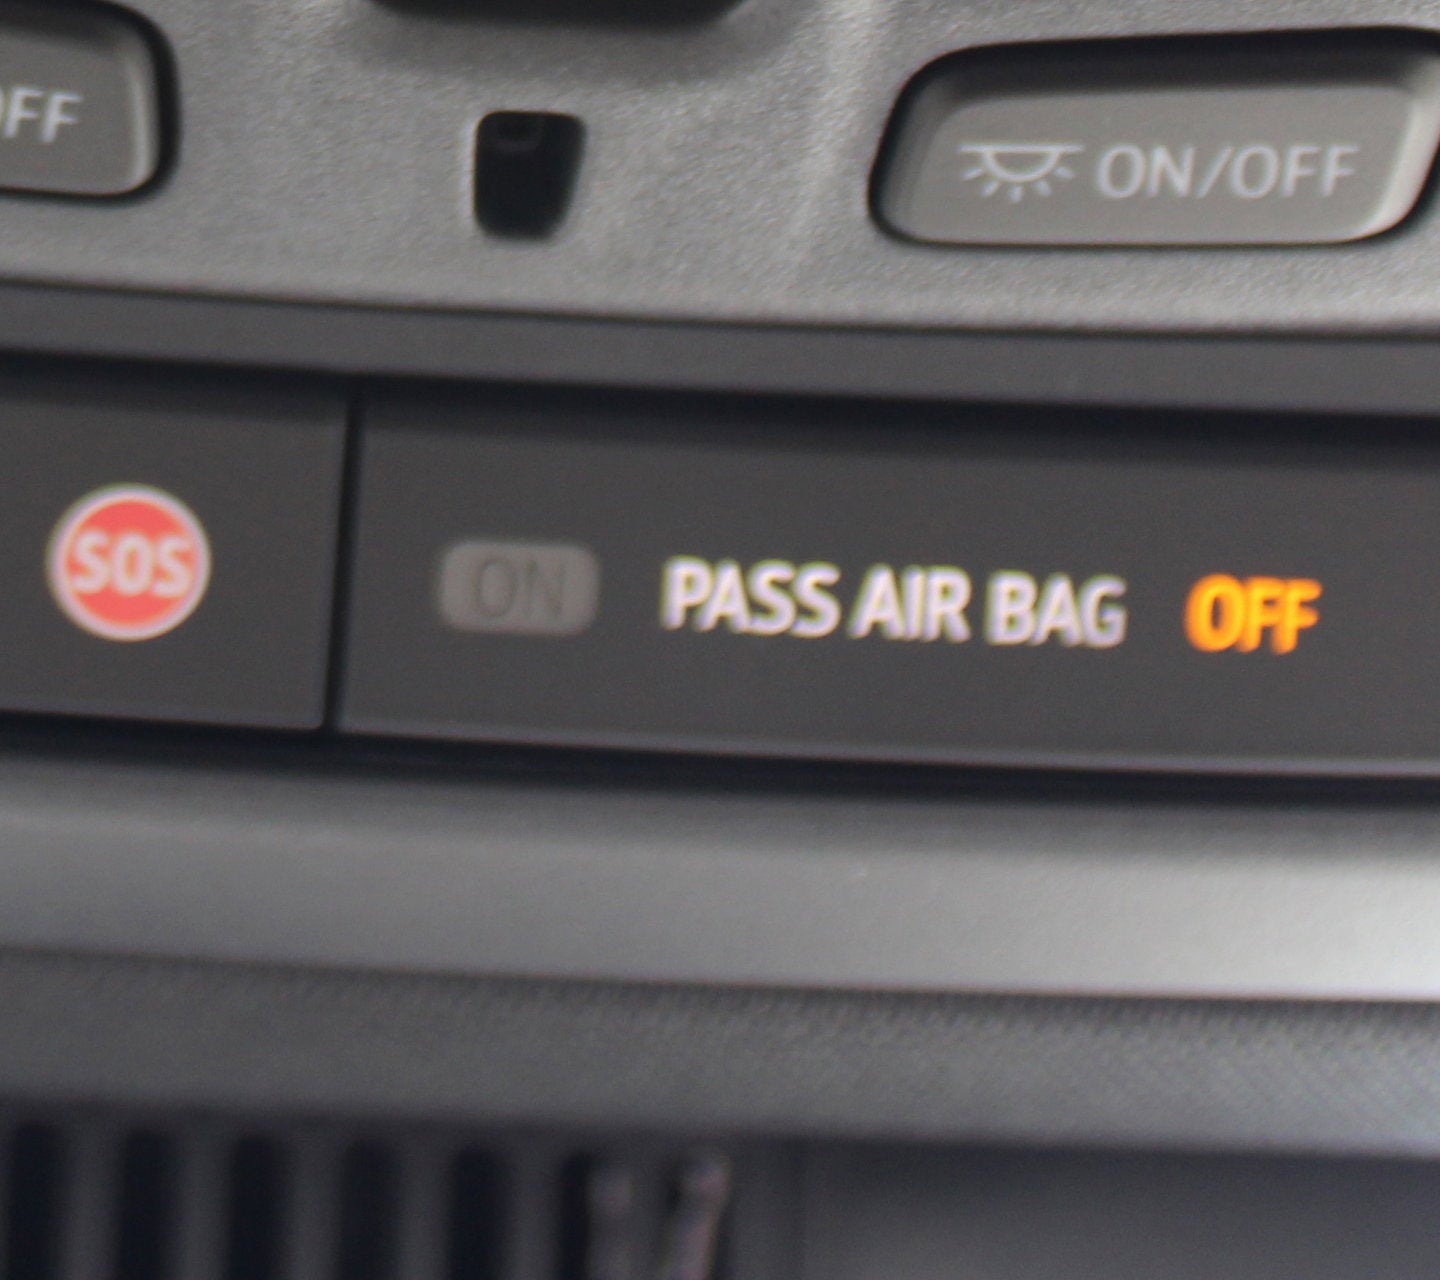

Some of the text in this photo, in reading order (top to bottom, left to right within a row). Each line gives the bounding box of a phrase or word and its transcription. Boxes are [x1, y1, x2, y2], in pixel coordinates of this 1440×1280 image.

[1095, 144, 1359, 201] ON/OFF
[69, 529, 196, 601] SOS
[472, 552, 572, 625] ON
[662, 556, 1321, 653] PASS AIR BAG OFF
